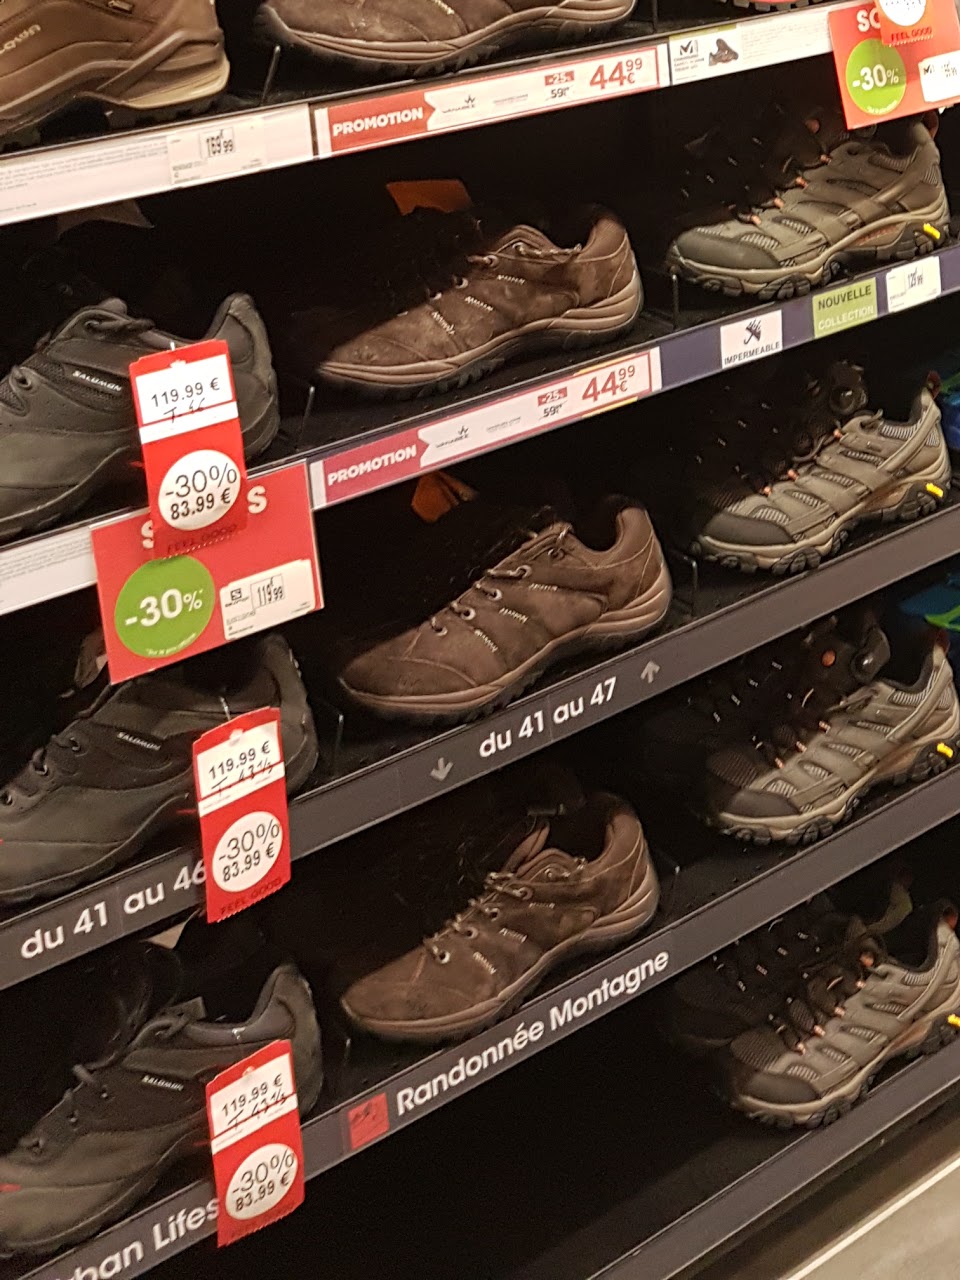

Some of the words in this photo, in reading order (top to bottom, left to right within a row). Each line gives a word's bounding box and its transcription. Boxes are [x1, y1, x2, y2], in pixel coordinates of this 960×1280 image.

[890, 30, 910, 42] FEEL
[911, 27, 932, 39] GOOD
[332, 106, 424, 137] PROMOTION
[818, 284, 872, 311] NOUVELLE
[818, 305, 874, 330] COLLECTION
[724, 341, 780, 366] IMPERMEABLE
[151, 382, 204, 408] 119.99
[210, 377, 220, 391] €
[165, 462, 237, 498] -30%
[328, 444, 418, 487] PROMOTION
[170, 494, 215, 521] 83.99
[220, 487, 231, 505] €
[125, 587, 203, 628] -30%
[479, 729, 512, 758] du
[518, 710, 544, 739] 41
[553, 697, 584, 725] au
[590, 676, 617, 705] 47
[208, 747, 257, 780] 119.99
[261, 740, 271, 755] €
[218, 819, 280, 863] -30%
[222, 850, 261, 883] 83.99
[266, 842, 276, 859] €
[20, 927, 65, 960] du
[73, 900, 109, 936] 41
[123, 881, 165, 914] au
[173, 861, 206, 891] 46
[396, 1020, 545, 1116] Randonnée
[549, 950, 670, 1031] Montagne
[222, 1082, 269, 1118] 119.99
[273, 1072, 283, 1087] €
[232, 1147, 296, 1195] -30%
[236, 1180, 275, 1212] 83.99
[280, 1171, 290, 1188] €
[56, 1240, 145, 1280] ban
[152, 1197, 219, 1251] Lifes
